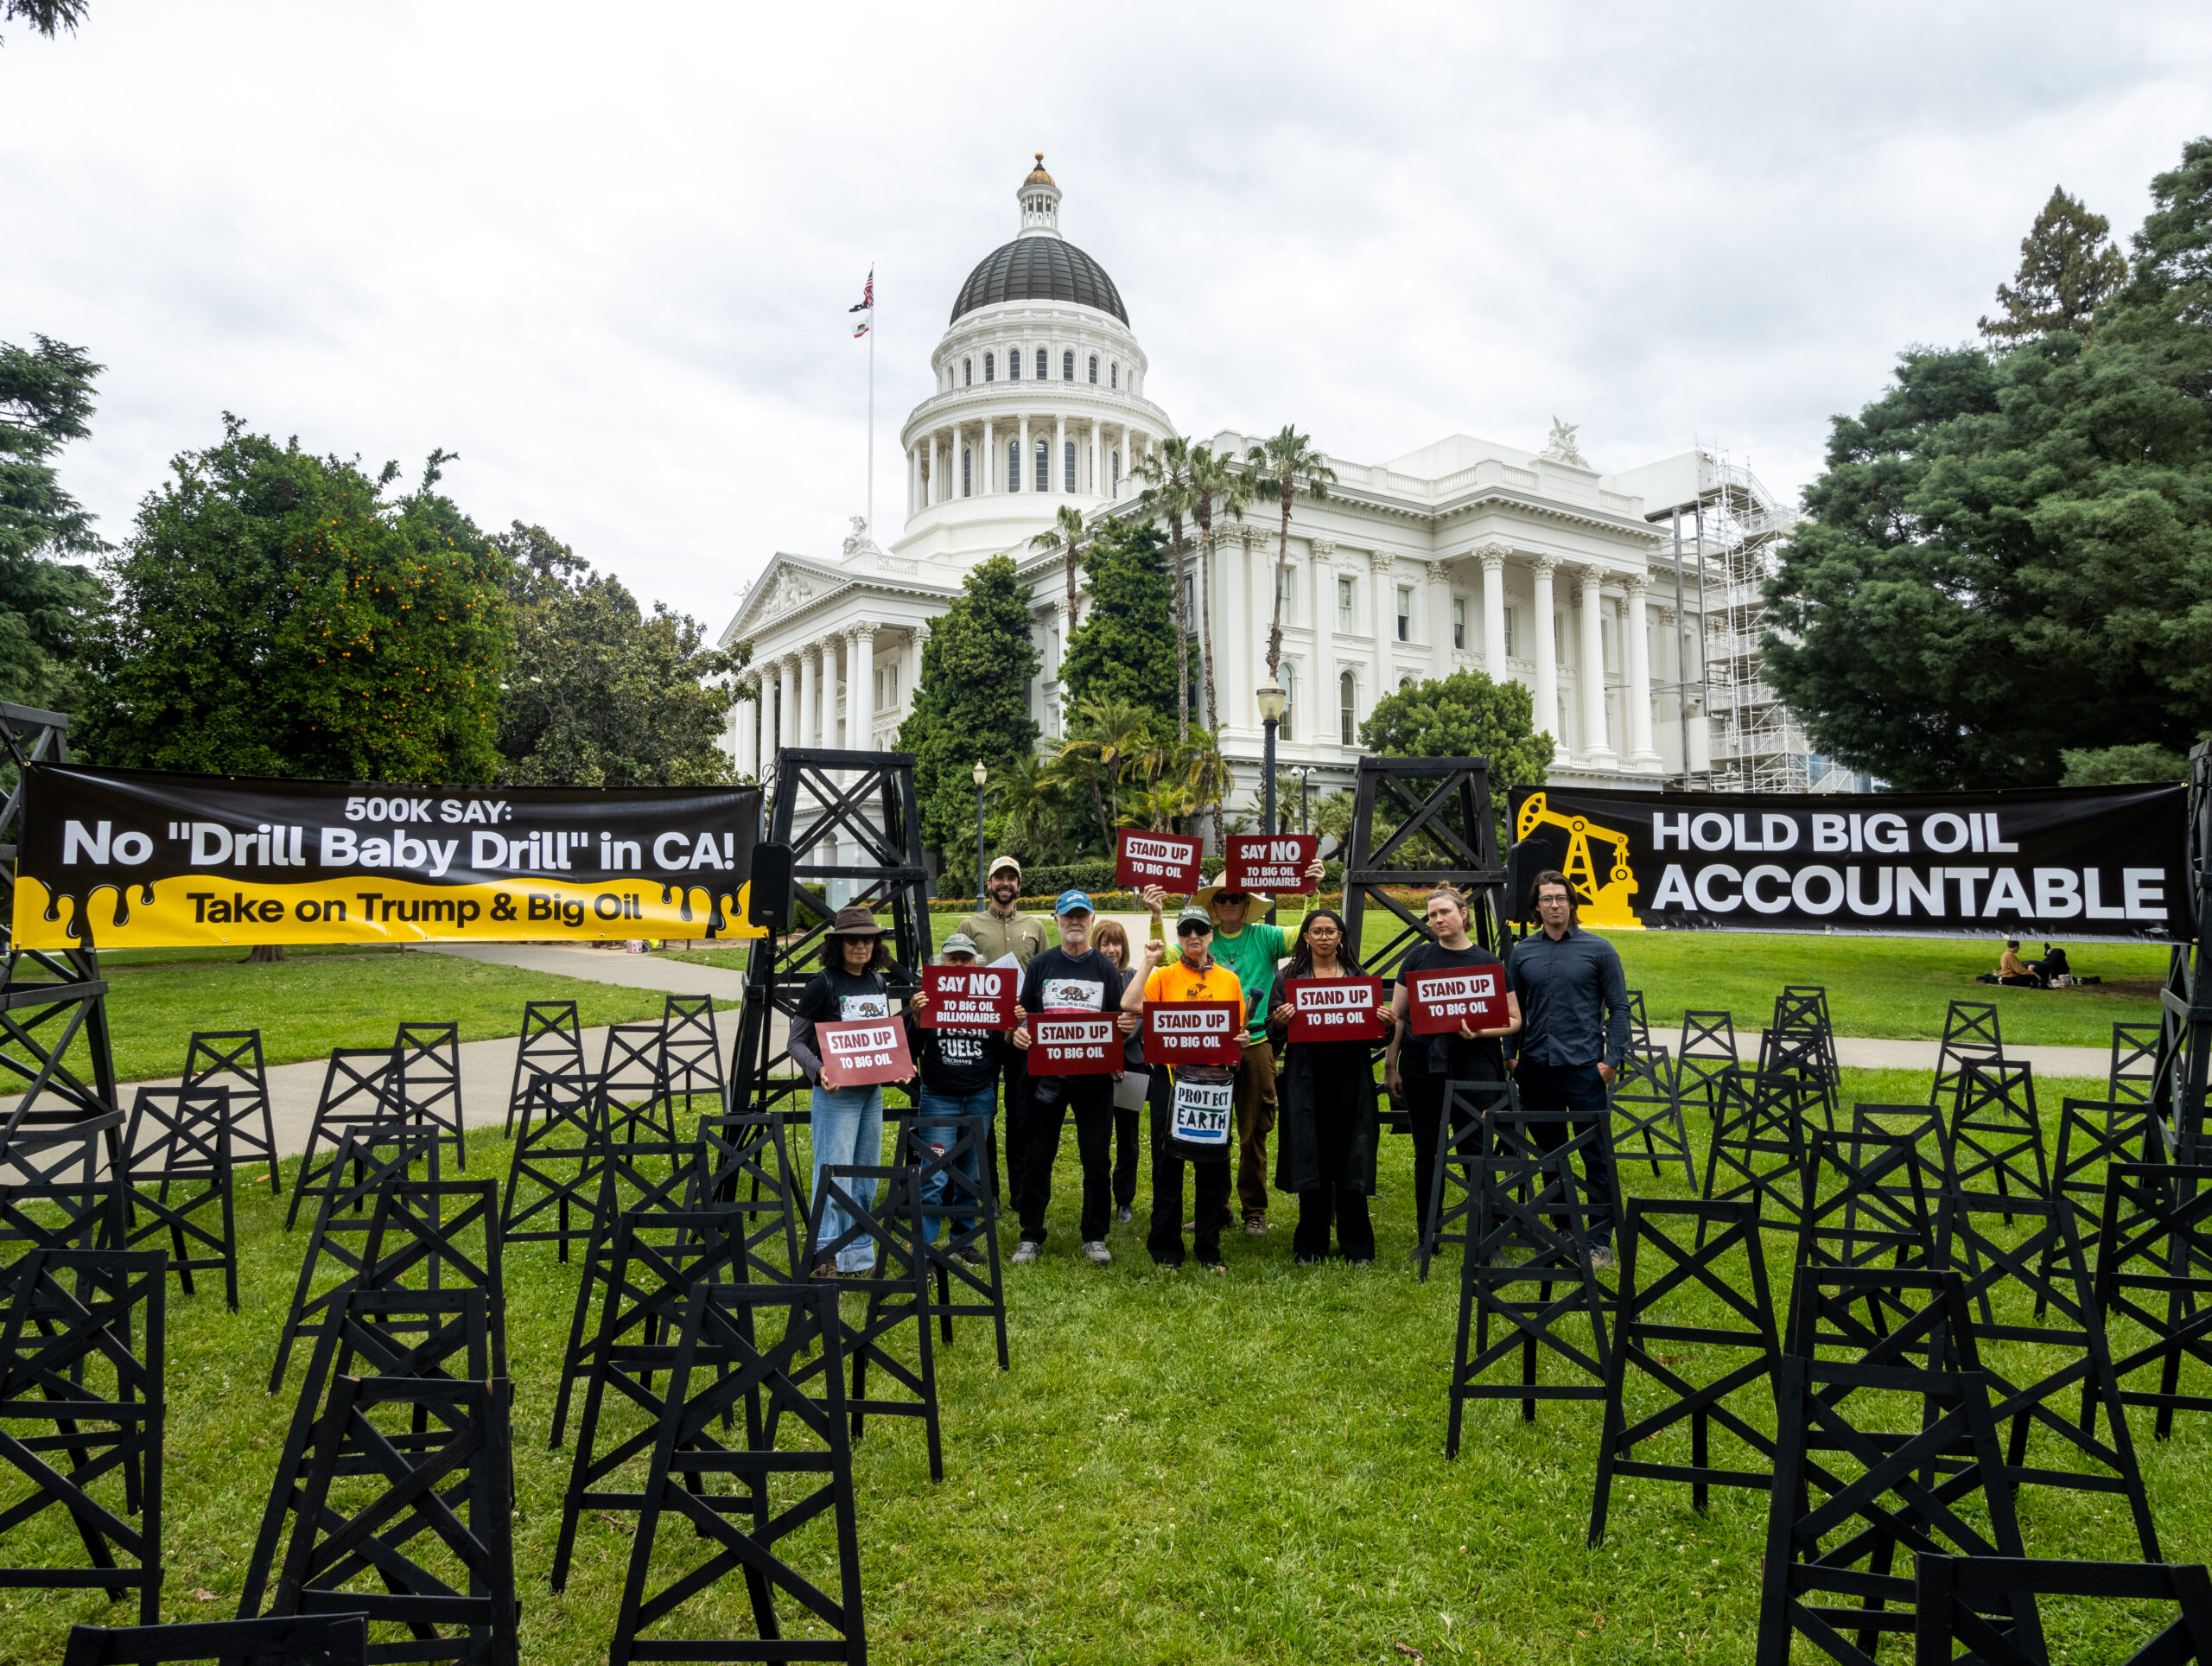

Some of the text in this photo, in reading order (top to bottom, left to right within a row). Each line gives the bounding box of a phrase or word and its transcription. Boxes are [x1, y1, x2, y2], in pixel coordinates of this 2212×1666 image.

[345, 797, 512, 823] 500K SAY:
[1653, 812, 2018, 853] HOLD BIG OIL
[62, 820, 734, 877] No "Drill Baby Drill" in CA!
[1129, 841, 1189, 860] STAND UP
[1241, 841, 1300, 862] SAY NO
[1132, 862, 1181, 878] TO BIG OIL
[1247, 867, 1294, 876] TO BIG OIL
[1241, 877, 1300, 887] BILLIONAIRES
[1651, 864, 2168, 919] ACCOUNTABLE
[187, 893, 642, 928] Take on Trump & Big Oil
[938, 973, 1001, 995] SAY NO
[1421, 979, 1490, 998] STAND UP
[944, 1000, 995, 1012] TO BIG OIL
[1300, 989, 1368, 1006] STAND UP
[937, 1011, 1001, 1023] BILLIONAIRES
[1428, 1002, 1488, 1017] TO BIG OIL
[1158, 1014, 1225, 1028] STAND UP
[1306, 1012, 1364, 1026] TO BIG OIL
[831, 1031, 892, 1049] STAND UP
[1041, 1026, 1109, 1040] STAND UP
[1163, 1036, 1221, 1047] TO BIG OIL
[938, 1039, 982, 1057] FUELS
[1046, 1046, 1104, 1059] TO BIG OIL
[840, 1052, 893, 1069] TO BIG OIL
[1177, 1108, 1225, 1129] EARTH
